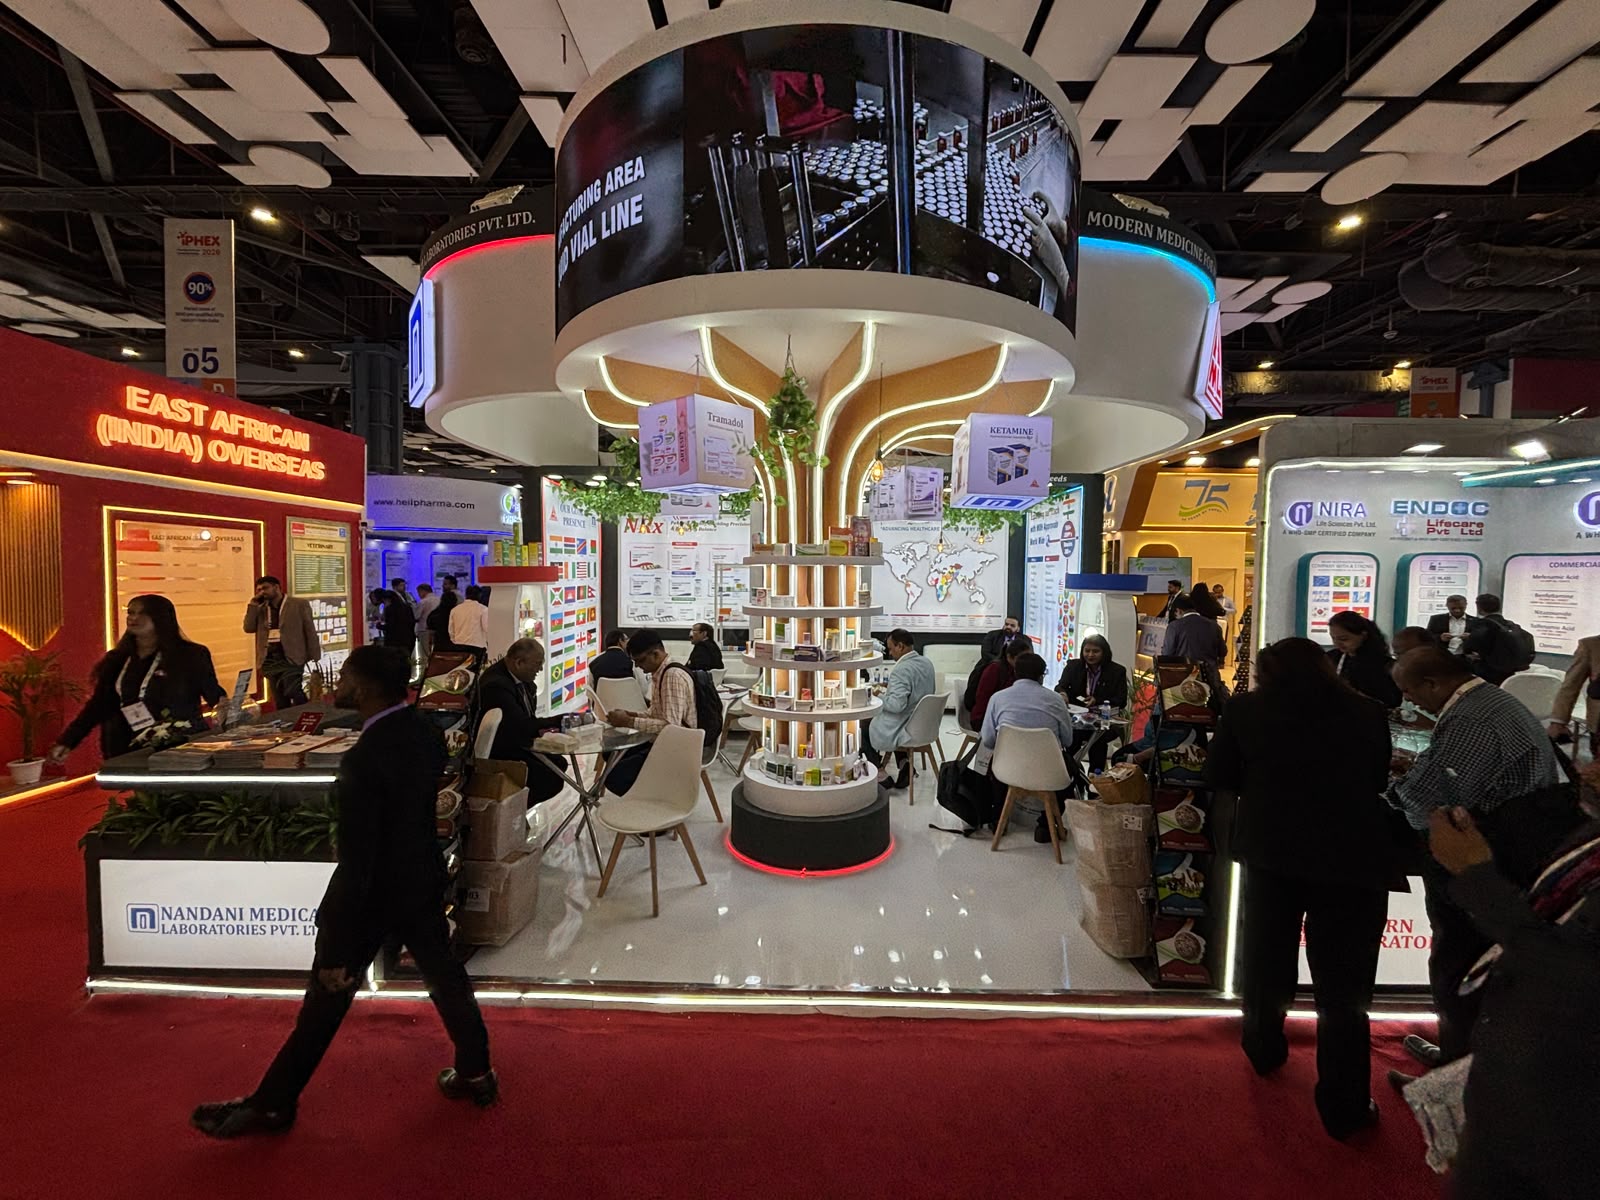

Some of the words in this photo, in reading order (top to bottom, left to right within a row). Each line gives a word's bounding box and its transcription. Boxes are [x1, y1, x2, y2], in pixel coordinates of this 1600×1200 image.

[604, 155, 645, 196] AREA
[478, 216, 504, 234] PVT.
[506, 211, 536, 227] LTD.
[570, 220, 597, 263] VIAL
[601, 193, 643, 240] LINE
[1087, 210, 1154, 238] MODERN
[1156, 226, 1204, 263] MEDICINE
[188, 282, 212, 296] 90%
[182, 347, 219, 374] 05
[125, 385, 209, 427] EAST
[210, 410, 310, 452] AFRICAN
[706, 411, 744, 428] Tramadol
[990, 426, 1034, 436] KETAMINE
[96, 413, 204, 464] (INDIA)
[207, 439, 325, 480] OVERSEAS
[1184, 480, 1231, 510] 75
[373, 498, 475, 510] www.heilpharma.com
[1319, 502, 1367, 518] NIRA
[1392, 500, 1490, 516] ENDOC
[1426, 519, 1484, 528] Lifecare
[1460, 528, 1483, 536] Ltd
[161, 906, 244, 922] NANDANI
[250, 907, 318, 922] MEDICA
[161, 924, 267, 936] LABORATORIES
[270, 924, 300, 936] PVT.
